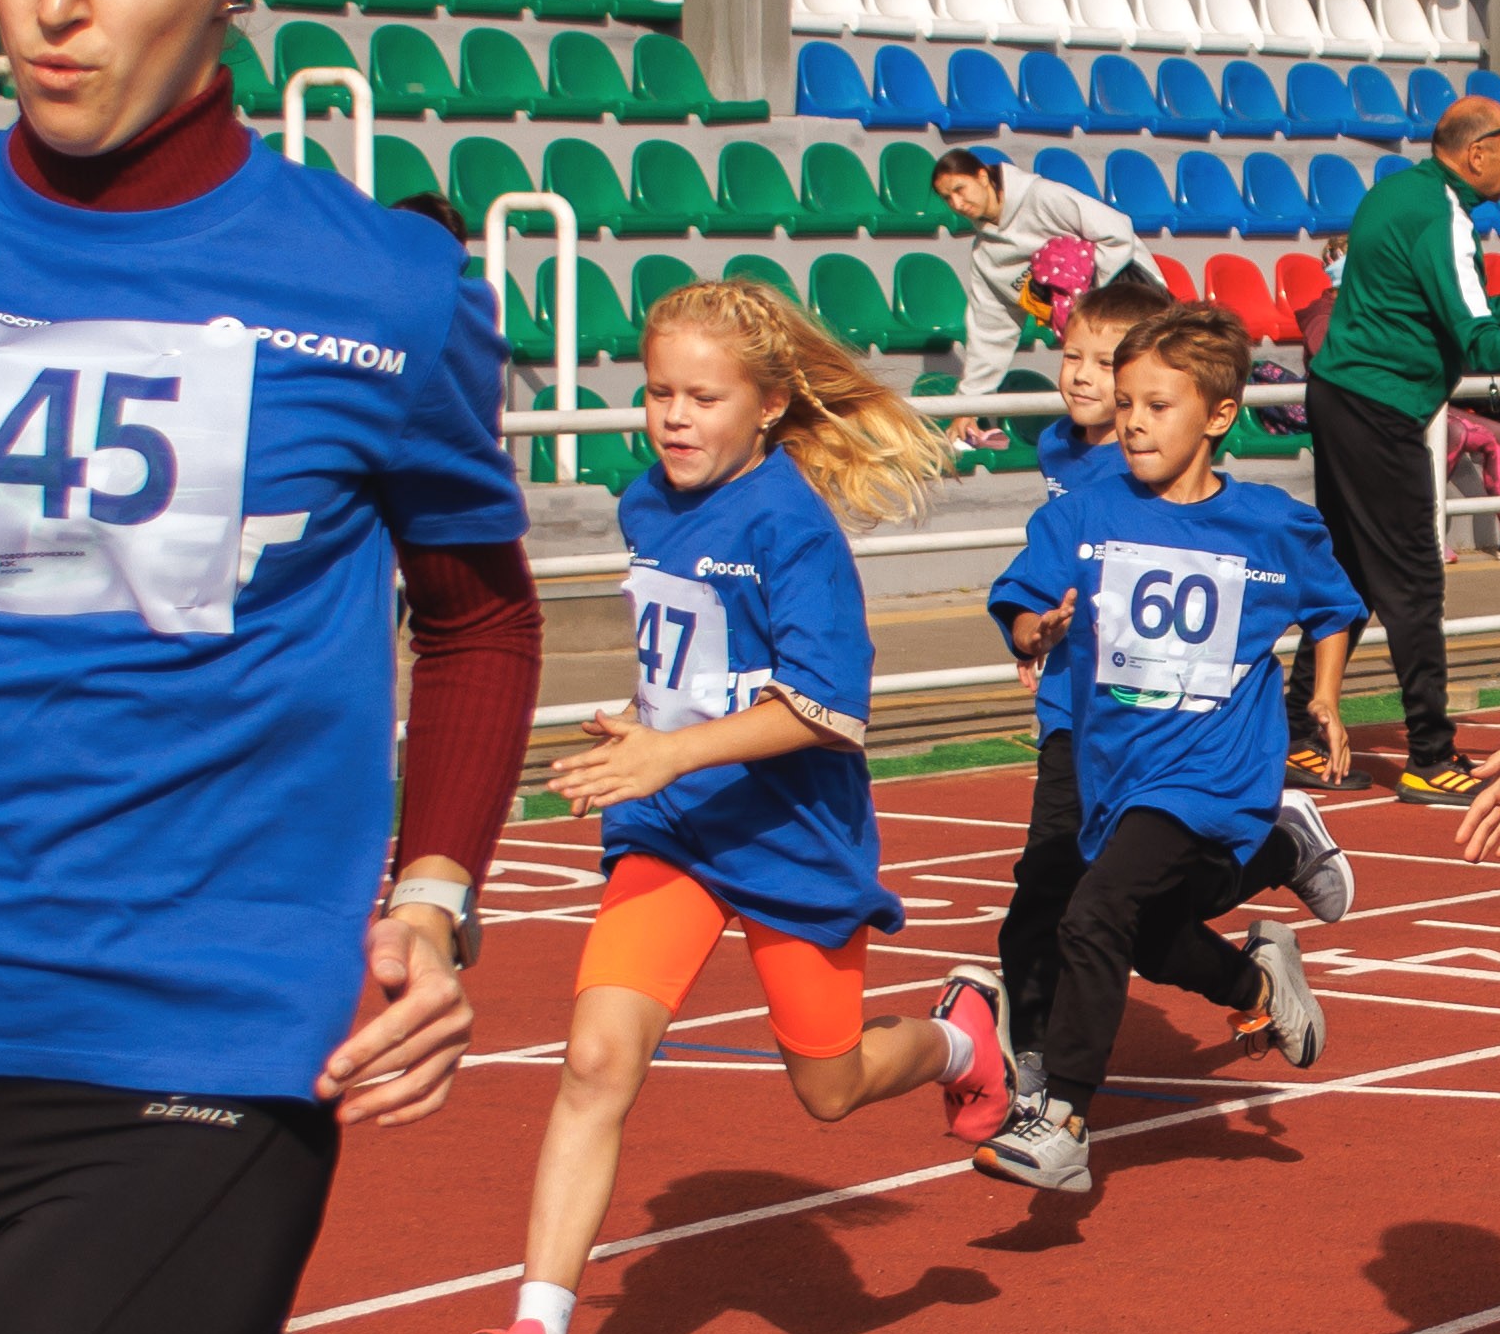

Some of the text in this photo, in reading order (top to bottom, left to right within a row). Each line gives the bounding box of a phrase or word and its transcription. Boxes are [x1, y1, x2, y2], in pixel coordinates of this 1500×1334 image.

[256, 327, 406, 375] РОСАТОМ
[1131, 569, 1219, 644] 60
[637, 601, 697, 690] 47
[143, 1103, 244, 1125] DEMIX
